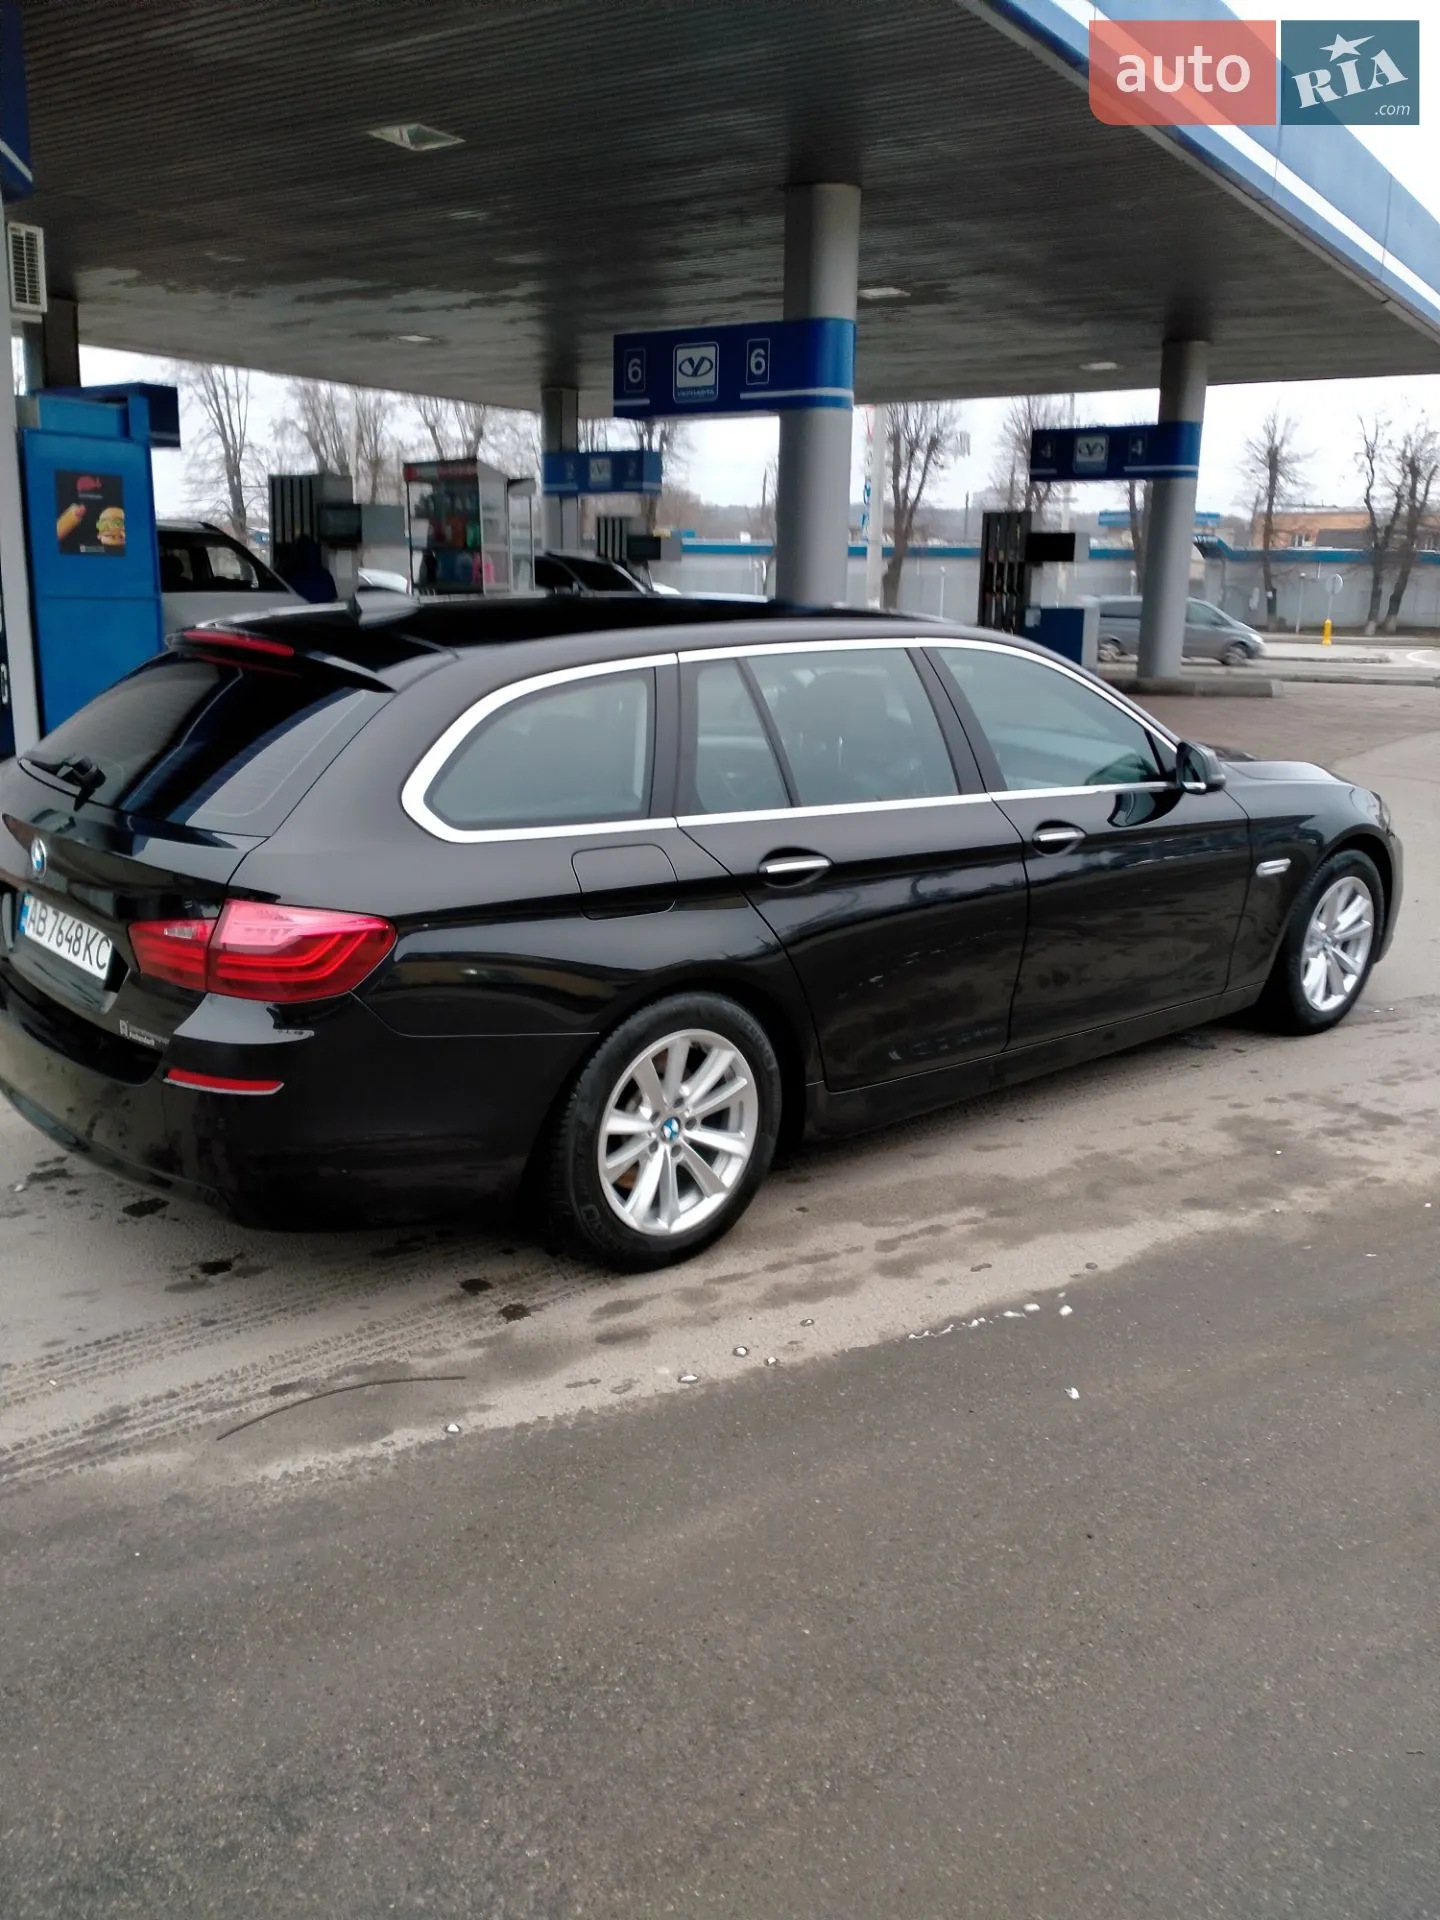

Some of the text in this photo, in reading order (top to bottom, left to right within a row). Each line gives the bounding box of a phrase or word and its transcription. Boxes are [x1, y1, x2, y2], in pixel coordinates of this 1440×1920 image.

[627, 358, 642, 383] 6
[750, 348, 766, 375] 6
[1132, 440, 1143, 456] 4
[47, 908, 84, 957] 7648
[82, 926, 110, 970] KC
